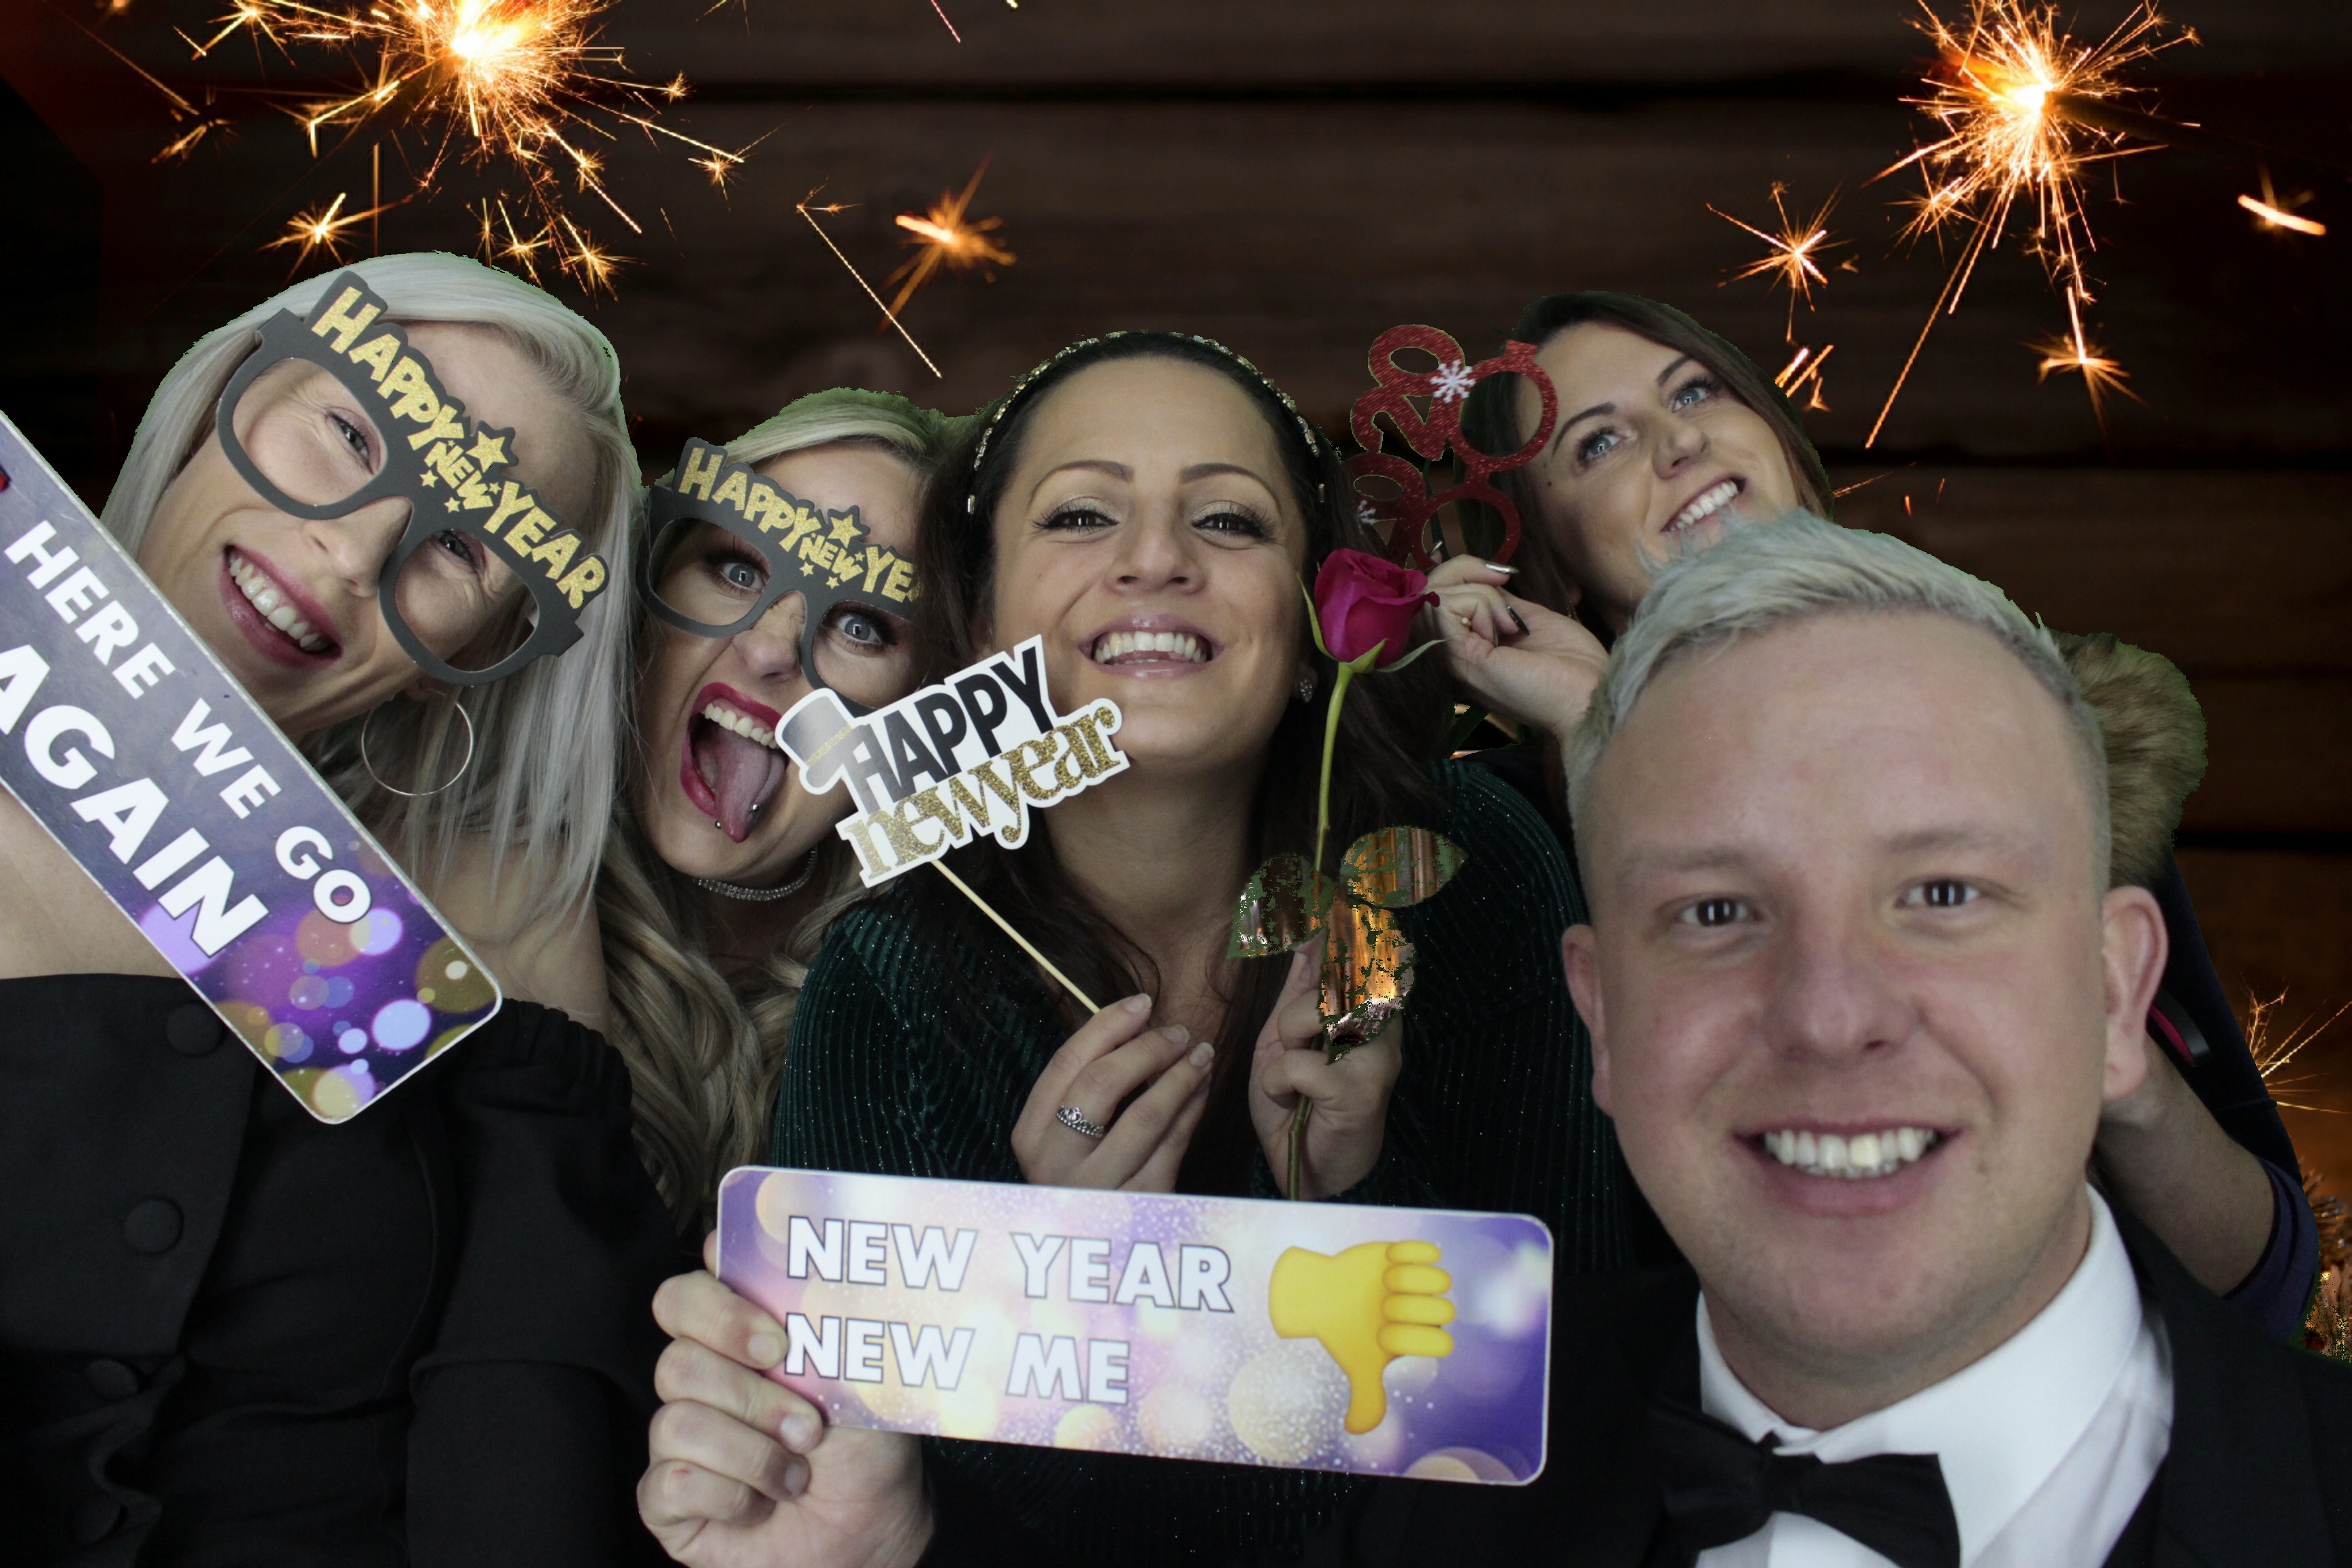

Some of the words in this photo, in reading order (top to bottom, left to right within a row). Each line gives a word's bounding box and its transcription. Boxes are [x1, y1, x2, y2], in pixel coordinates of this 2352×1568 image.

[311, 286, 466, 451] HAPPY
[424, 441, 493, 510] NEW
[483, 481, 606, 610] YEAR
[679, 447, 821, 552] HAPPY
[798, 535, 864, 583] NEW
[862, 546, 924, 603] YE
[0, 644, 268, 956] AGAIN
[3, 519, 176, 699] HERE
[172, 698, 281, 819] WE
[274, 826, 372, 924] GO
[841, 646, 1055, 815] HAPPY
[787, 1215, 979, 1292] NEW
[1010, 1232, 1235, 1313] YEAR
[785, 1312, 975, 1390] NEW
[1005, 1333, 1131, 1405] ME
